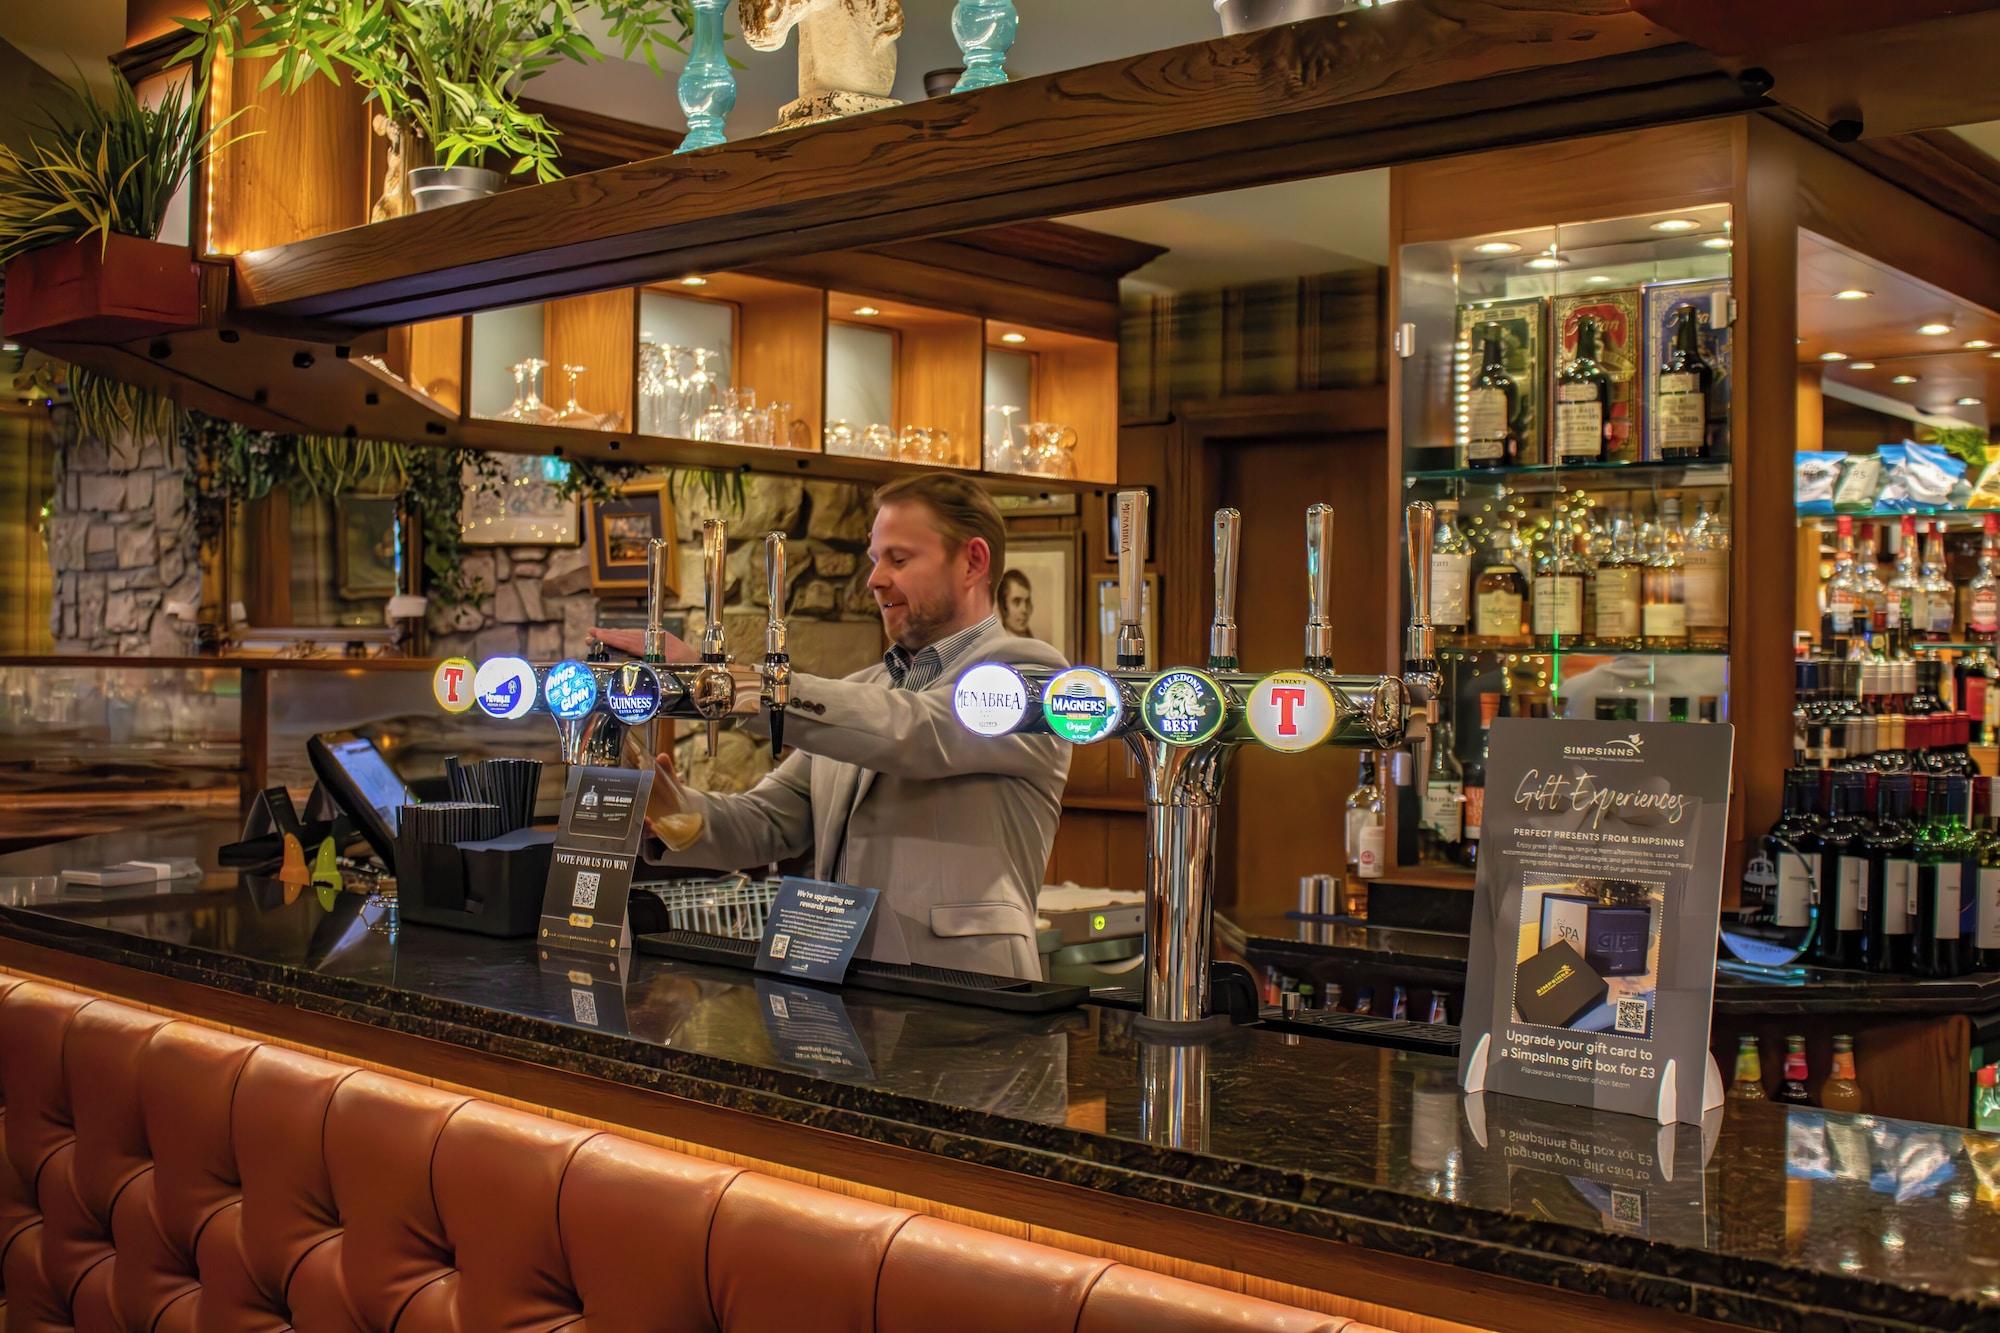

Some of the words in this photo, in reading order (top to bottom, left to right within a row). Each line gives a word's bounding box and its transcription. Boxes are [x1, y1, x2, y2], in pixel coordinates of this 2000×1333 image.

[444, 667, 464, 702] T
[1158, 673, 1205, 699] CALEDONIA
[560, 687, 589, 711] GUNN
[609, 696, 653, 710] GUINNESS
[958, 689, 1022, 710] MENABREA
[1052, 699, 1106, 713] MAGNERS
[1270, 687, 1306, 736] T
[1162, 719, 1198, 732] BEST
[1563, 746, 1634, 756] SIMPSINNS
[1514, 768, 1569, 811] Gift
[1570, 772, 1692, 829] Experiences
[1513, 828, 1552, 837] PERFECT
[1554, 830, 1600, 841] PRESENTS
[1602, 833, 1629, 843] FROM
[1631, 836, 1685, 847] SIMPSINNS
[556, 853, 575, 865] VOTE
[576, 855, 591, 867] FOR
[591, 857, 602, 868] US
[602, 858, 613, 869] TO
[613, 859, 629, 870] WIN
[796, 889, 813, 899] We're
[813, 893, 844, 906] upgrading
[844, 898, 855, 906] our
[799, 901, 824, 910] rewards
[824, 905, 845, 914] system
[1558, 925, 1580, 941] SPA
[1506, 1029, 1556, 1046] Upgrade
[1557, 1039, 1584, 1051] your
[1586, 1042, 1607, 1054] gift
[1609, 1045, 1637, 1058] card
[1639, 1049, 1653, 1061] to
[1501, 1048, 1508, 1057] a
[1510, 1047, 1569, 1067] SimpsInns
[1571, 1057, 1593, 1071] gift
[1595, 1060, 1617, 1073] box
[1619, 1063, 1638, 1076] for
[1639, 1067, 1655, 1079] £3
